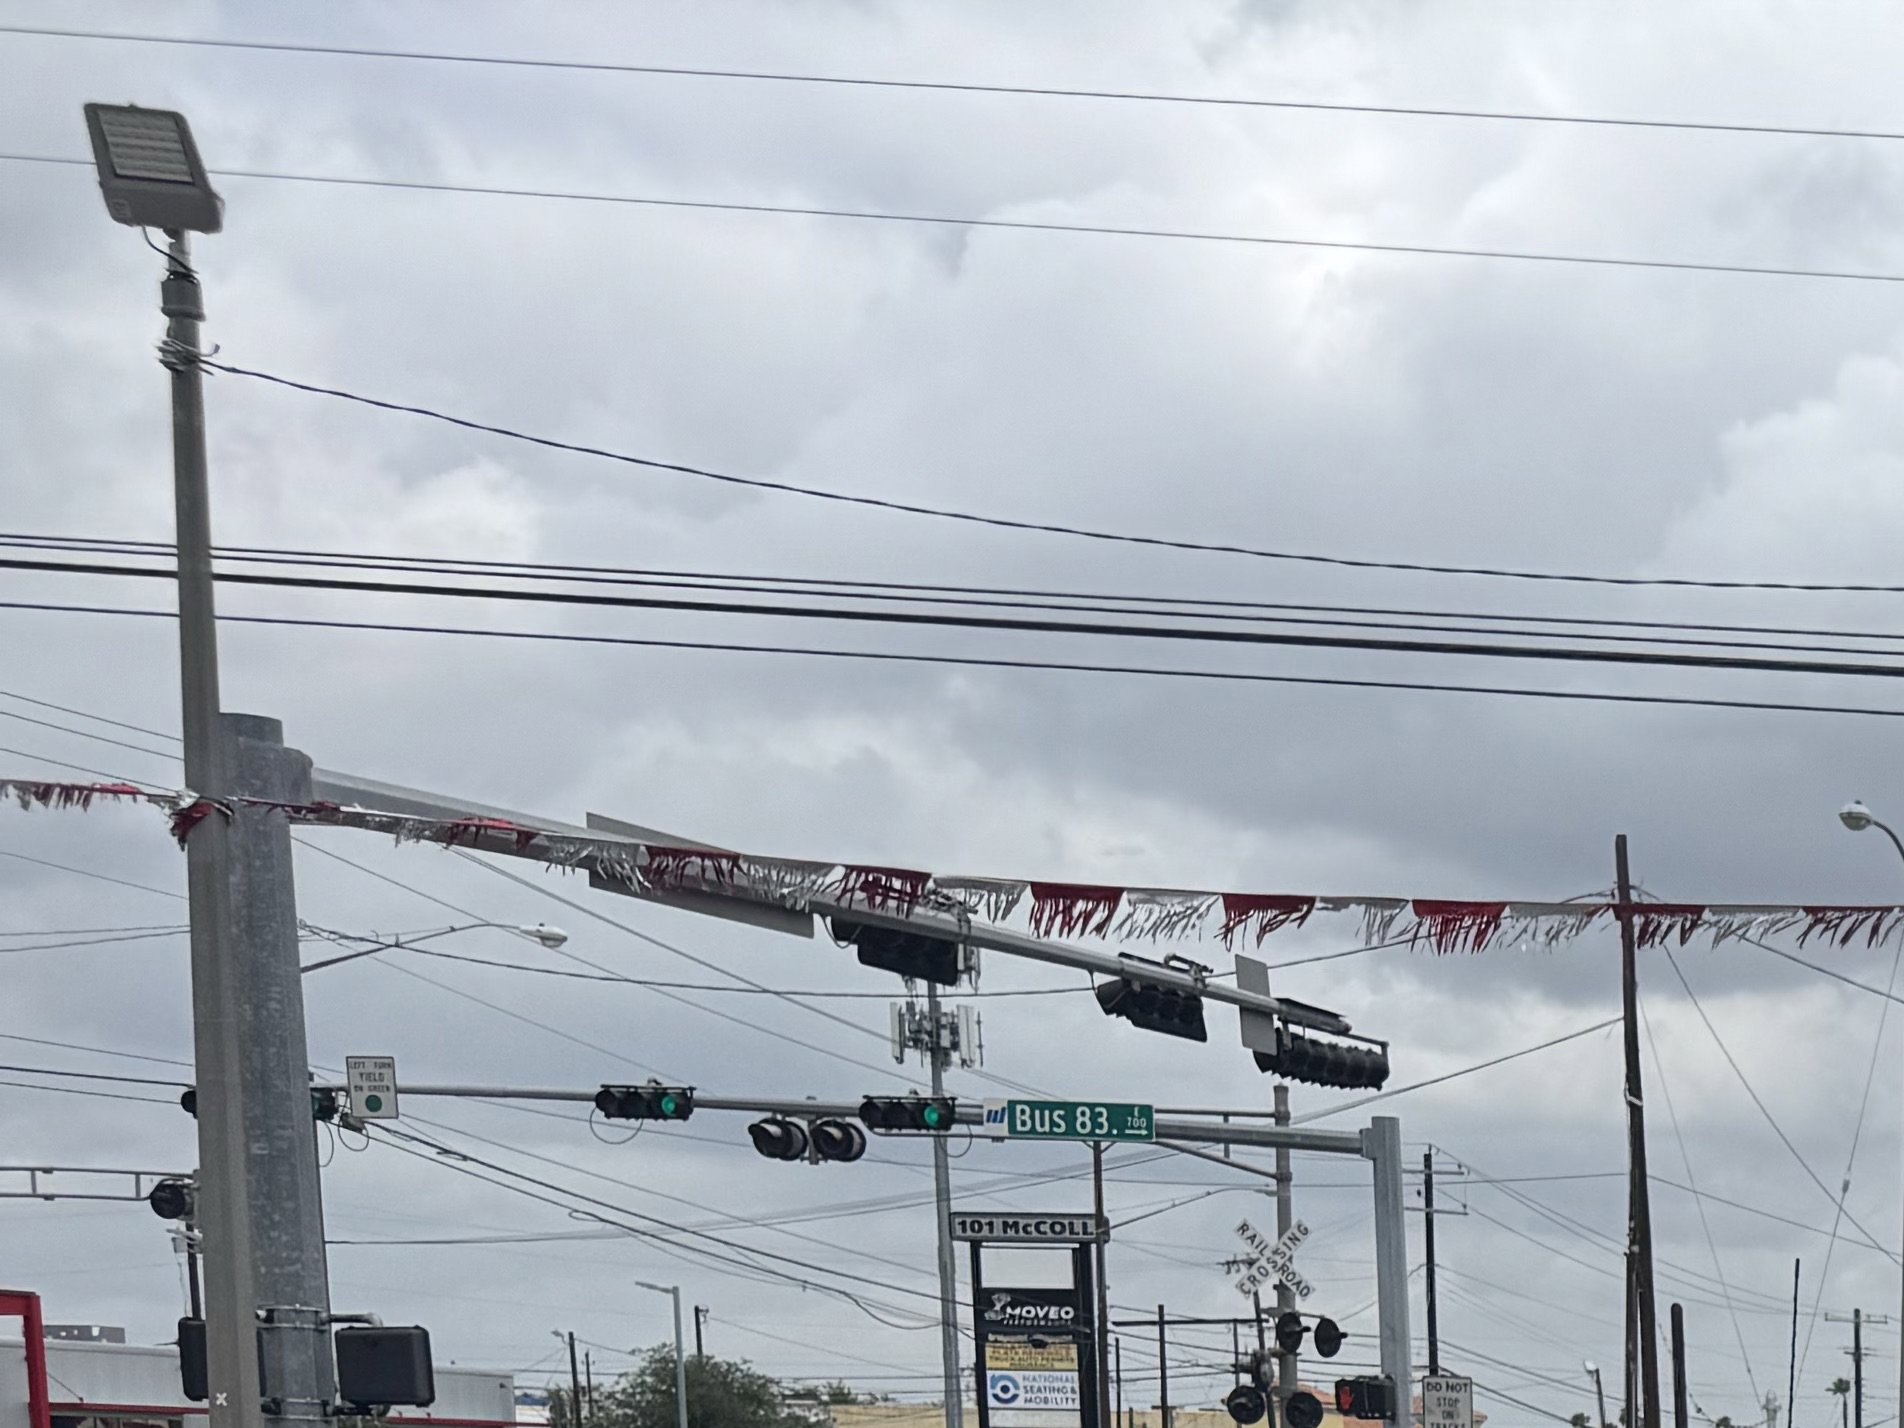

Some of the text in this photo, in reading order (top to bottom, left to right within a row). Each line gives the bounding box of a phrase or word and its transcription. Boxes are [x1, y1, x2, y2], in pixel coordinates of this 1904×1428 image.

[349, 1061, 392, 1070] LEFT TURN
[359, 1071, 385, 1082] YIELD
[353, 1084, 391, 1093] ON GREEN
[1015, 1104, 1067, 1134] Bus
[1126, 1116, 1148, 1129] 700
[957, 1219, 1094, 1237] 101 McCOLL
[1239, 1223, 1309, 1295] CROSSING
[1005, 1305, 1075, 1320] MOVEO
[1022, 1373, 1075, 1384] NATIONAL
[1023, 1384, 1068, 1395] SEATING
[1426, 1381, 1469, 1393] DO NOT
[1023, 1395, 1077, 1406] MOBILITY
[1436, 1397, 1461, 1409] STOP
[1441, 1410, 1455, 1420] ON
